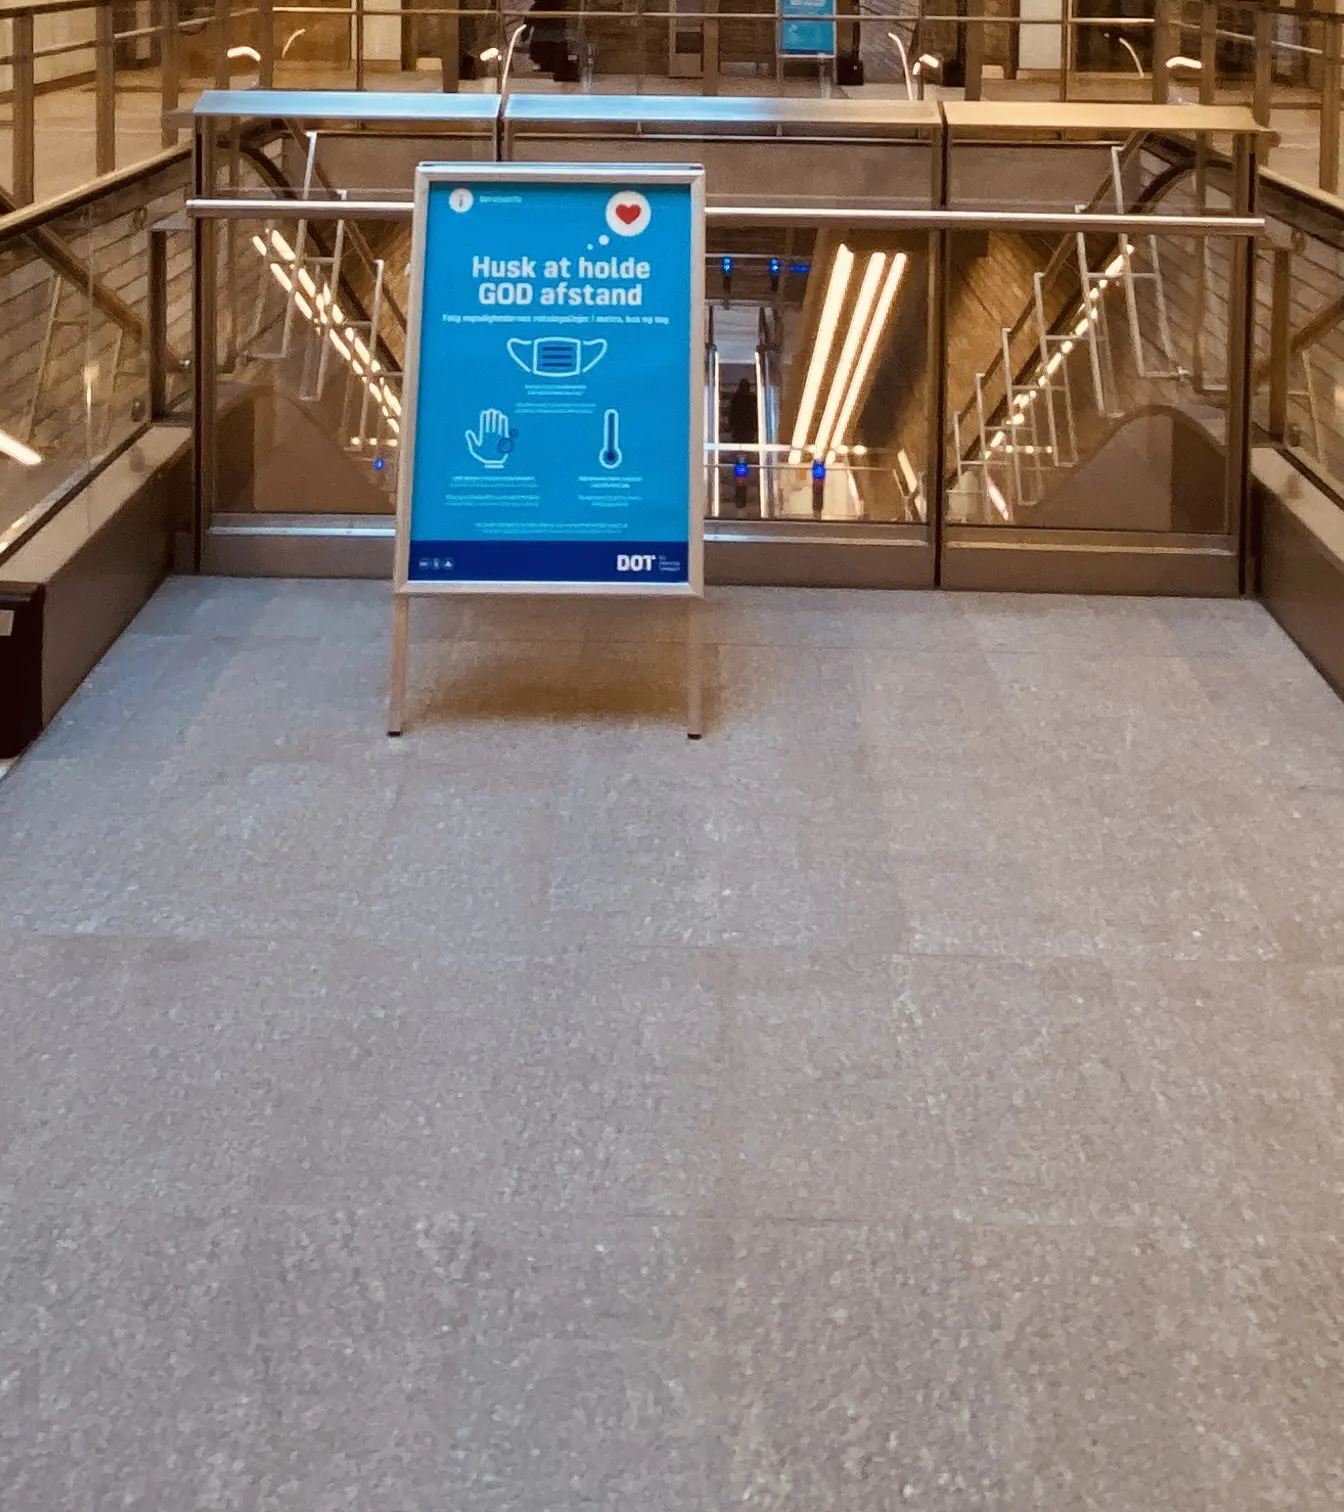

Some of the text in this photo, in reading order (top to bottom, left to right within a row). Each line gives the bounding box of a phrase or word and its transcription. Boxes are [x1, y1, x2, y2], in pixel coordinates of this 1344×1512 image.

[472, 256, 651, 279] Husk at holde
[478, 282, 643, 306] GOD afstand
[617, 554, 656, 572] DOT
